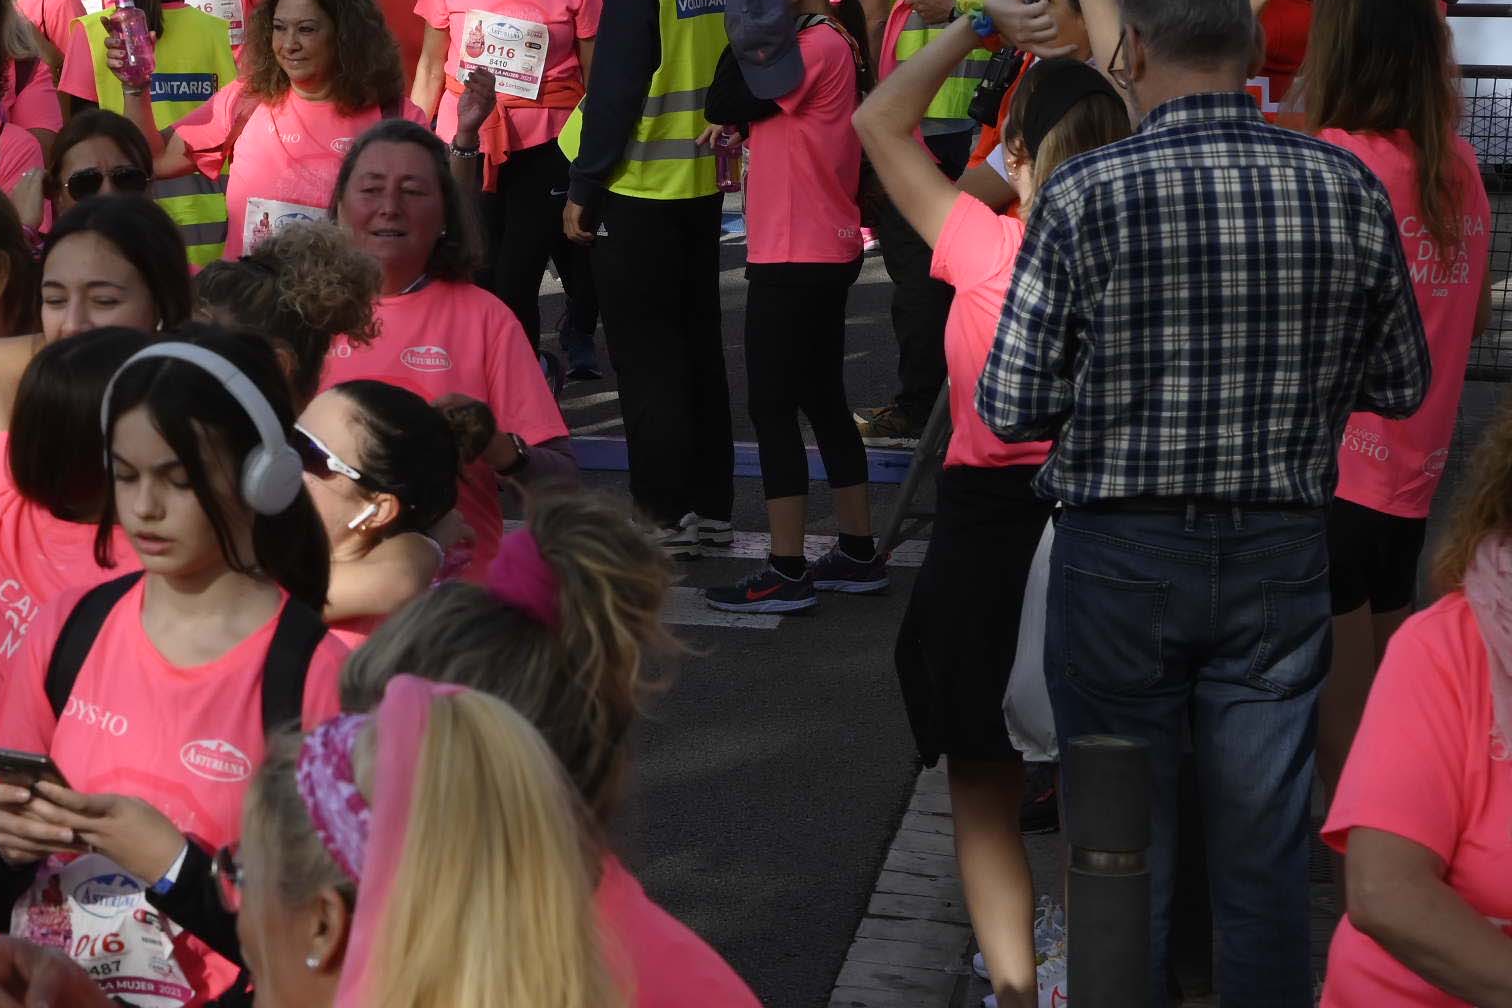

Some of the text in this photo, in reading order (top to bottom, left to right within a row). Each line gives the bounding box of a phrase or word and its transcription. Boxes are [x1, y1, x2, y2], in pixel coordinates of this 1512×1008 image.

[486, 44, 516, 59] 016
[186, 747, 246, 777] ASTURIANA
[74, 932, 125, 957] 016
[116, 981, 154, 992] MUJER
